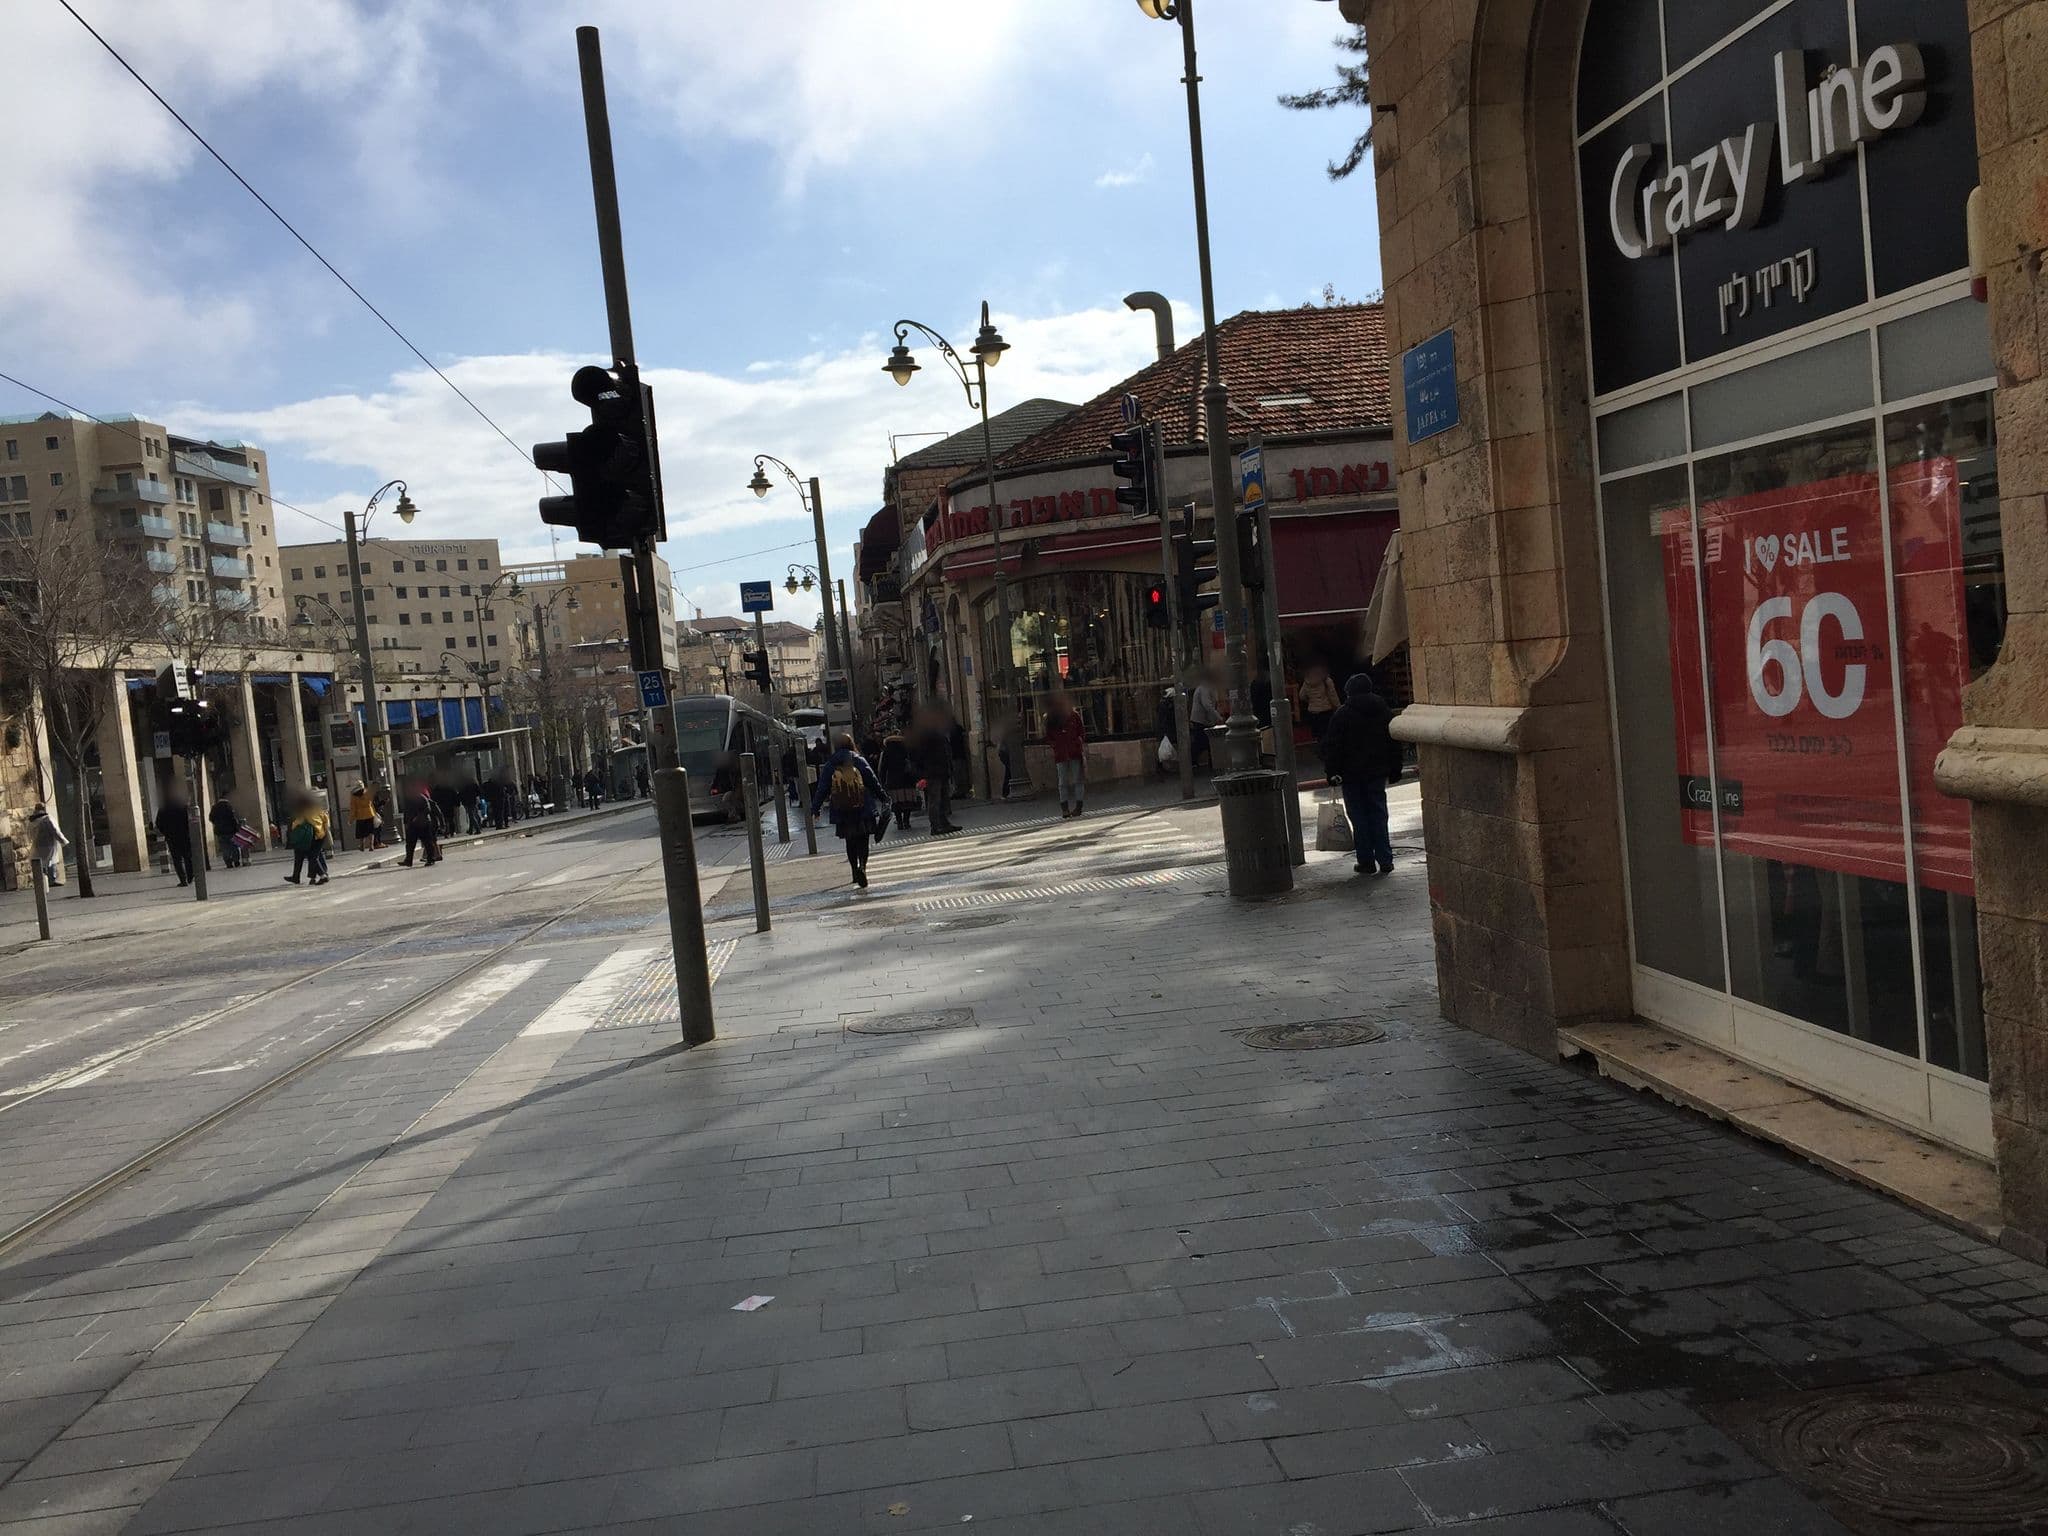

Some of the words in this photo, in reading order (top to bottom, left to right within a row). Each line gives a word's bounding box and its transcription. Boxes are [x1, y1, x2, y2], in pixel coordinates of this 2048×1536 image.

[1610, 122, 1774, 259] Crazy
[1774, 43, 1925, 185] Line
[1756, 247, 1816, 308] קרייזי
[1718, 271, 1750, 335] ליין
[1417, 409, 1438, 434] JAFFA
[1289, 460, 1389, 504] נאמן
[1009, 487, 1118, 528] מאפה
[1783, 526, 1852, 567] SALE
[643, 675, 660, 690] 25
[1686, 780, 1712, 804] Craz
